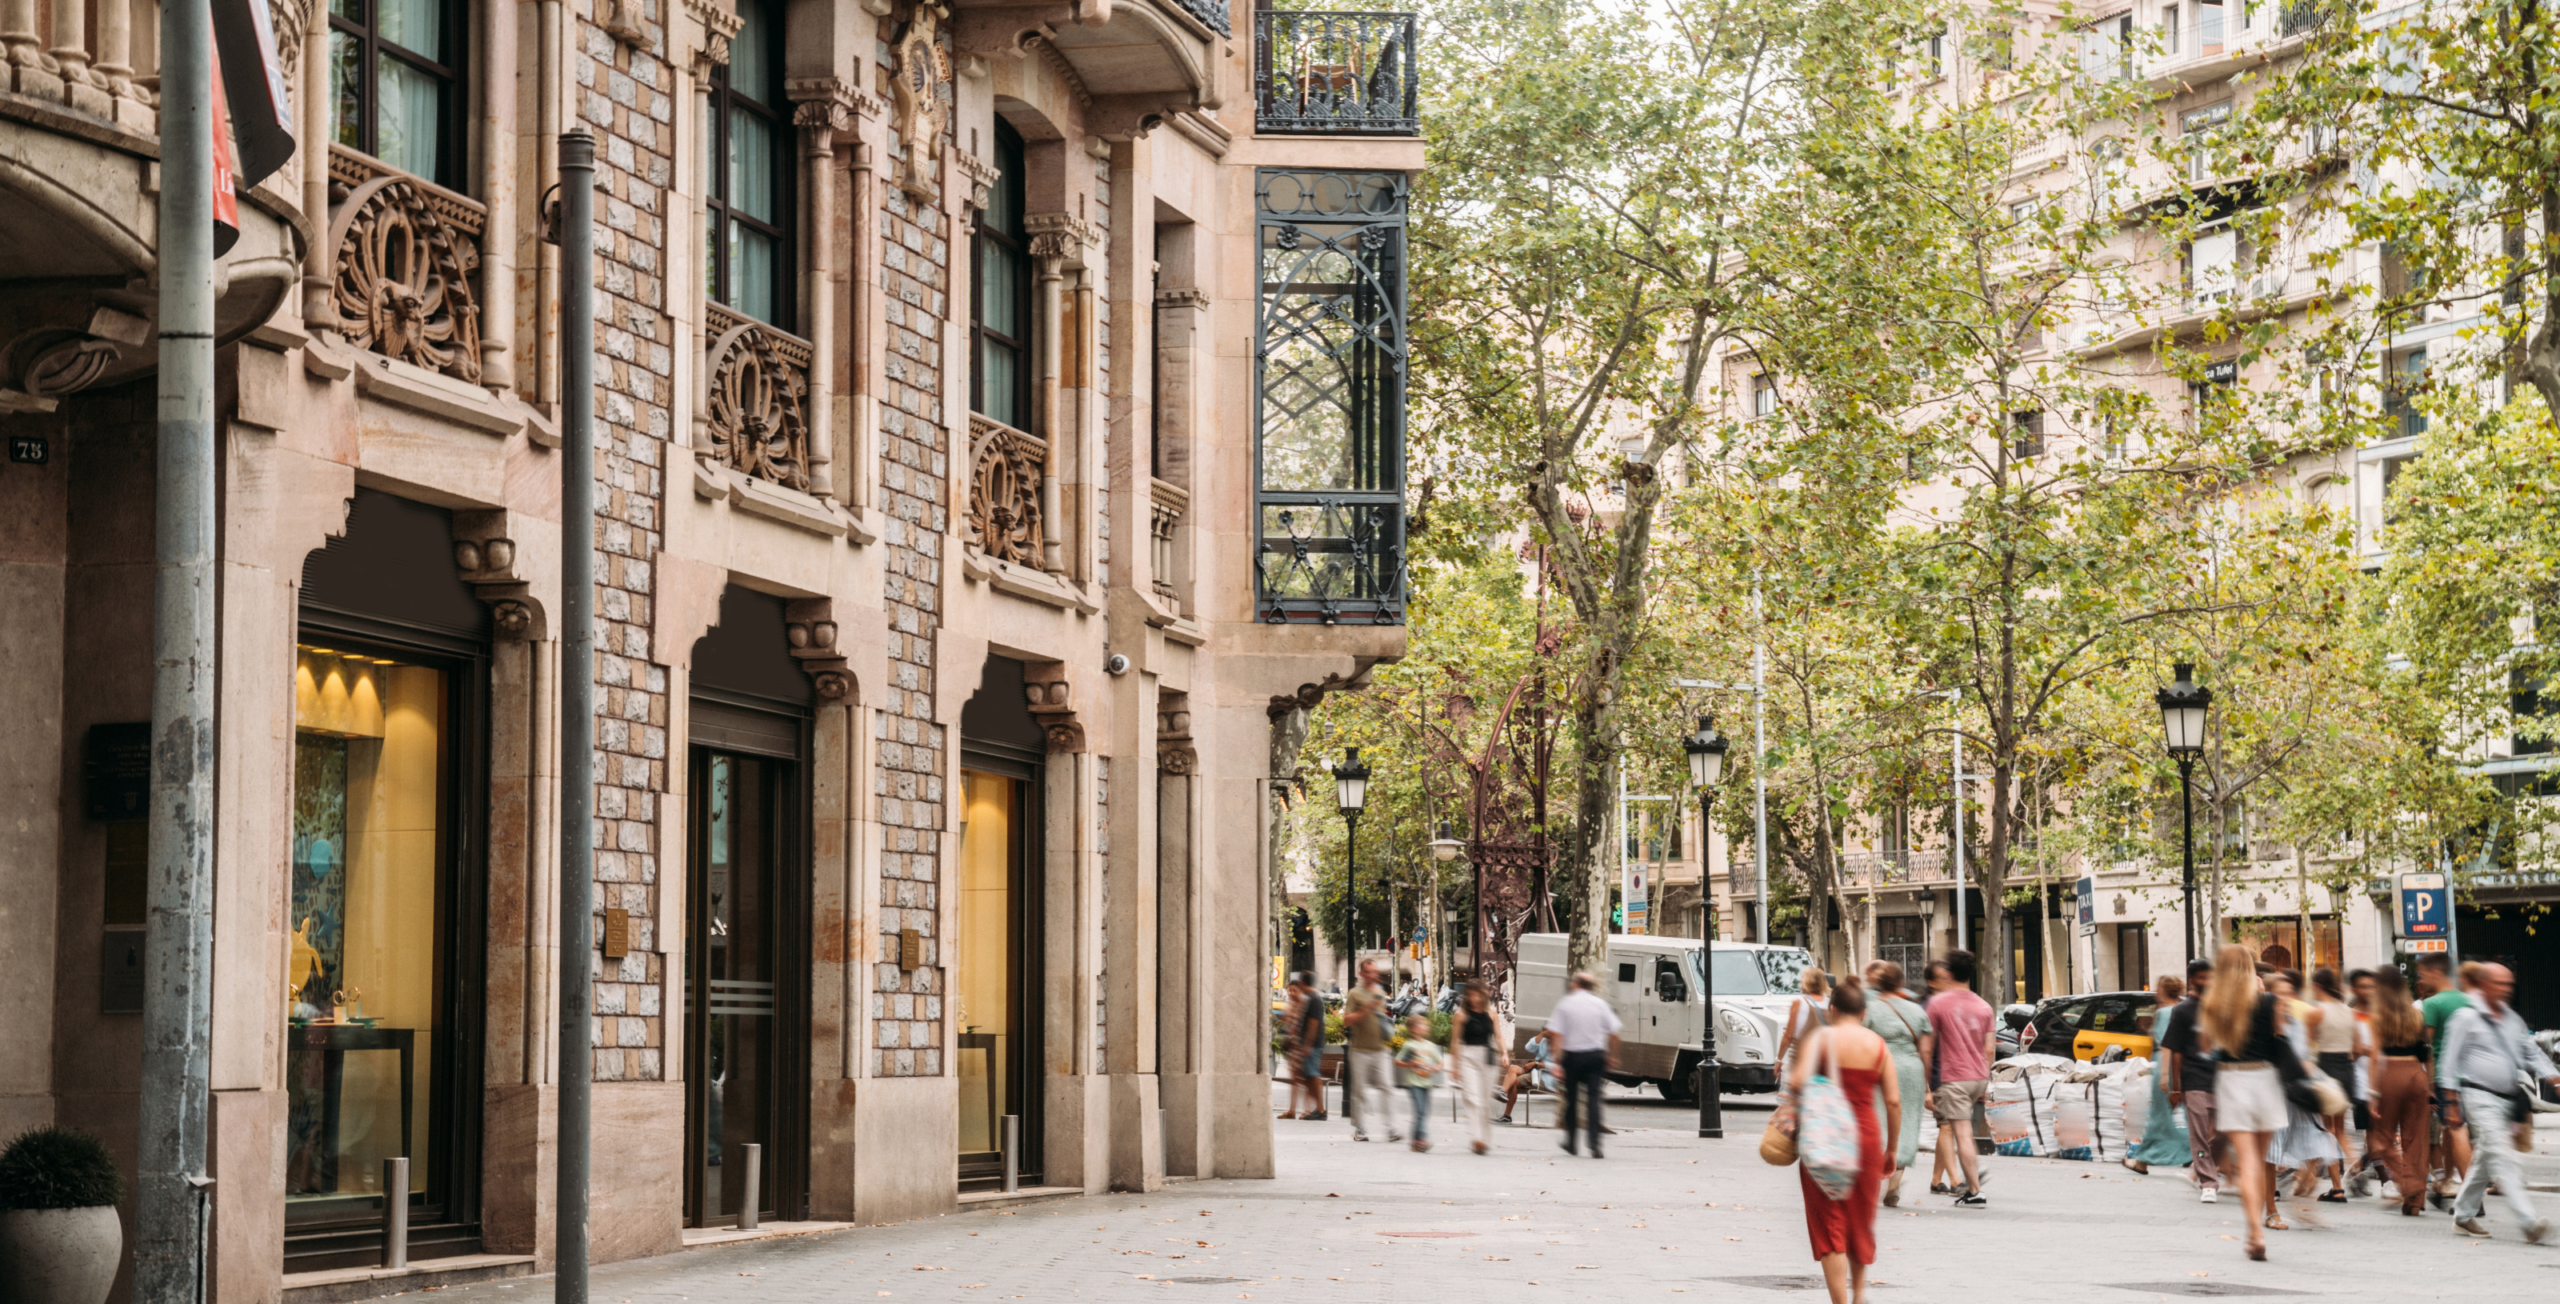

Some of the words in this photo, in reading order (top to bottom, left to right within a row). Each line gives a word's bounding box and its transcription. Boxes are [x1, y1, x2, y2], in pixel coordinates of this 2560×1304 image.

[2212, 106, 2229, 119] Tufet
[2216, 364, 2233, 376] Tufet
[2078, 893, 2092, 909] TAXI
[2416, 892, 2432, 921] P
[2400, 962, 2407, 974] P
